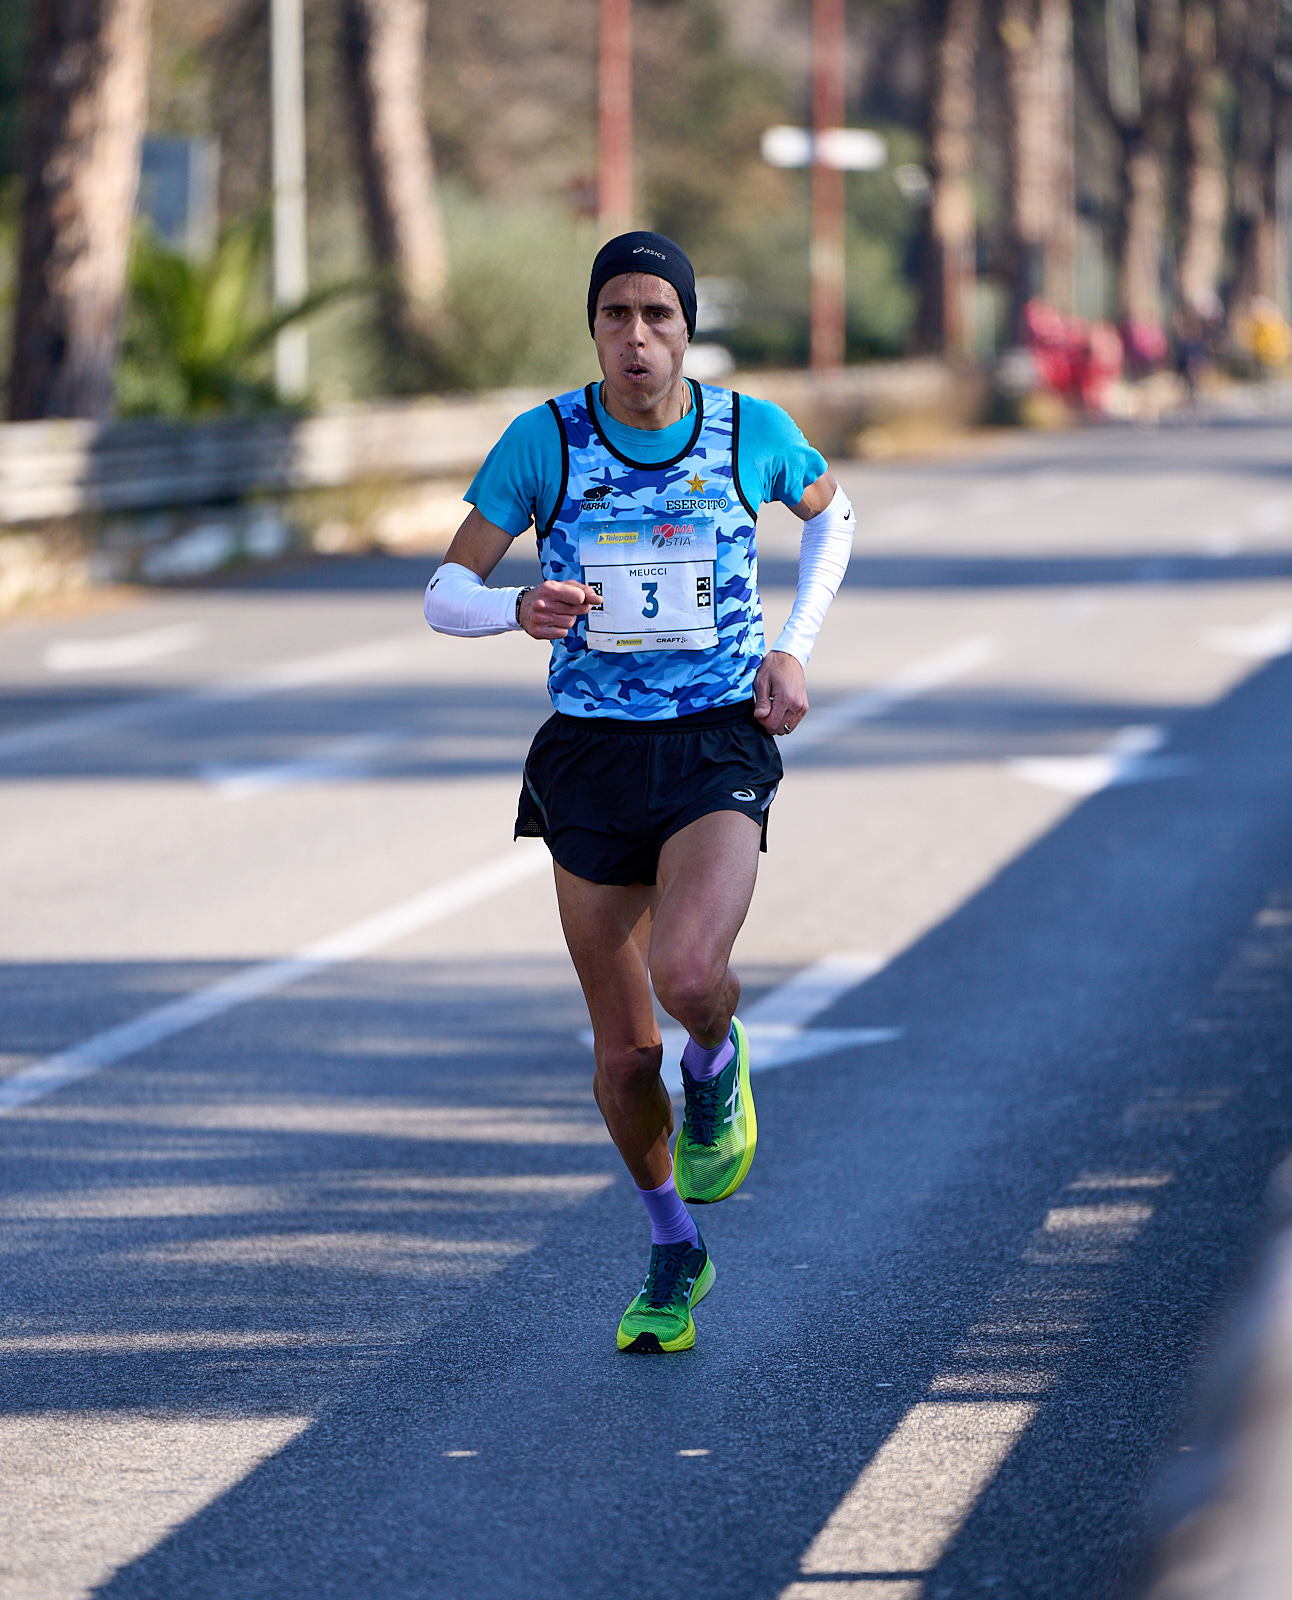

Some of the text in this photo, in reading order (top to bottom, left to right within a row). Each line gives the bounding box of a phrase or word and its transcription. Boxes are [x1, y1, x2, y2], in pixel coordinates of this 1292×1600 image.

[643, 248, 667, 260] asics
[580, 502, 610, 511] KARHU
[666, 498, 727, 511] ESERCITO
[653, 523, 695, 538] ROMA
[605, 534, 637, 542] Telepass
[629, 567, 667, 577] MEUCCI
[641, 582, 659, 618] 3
